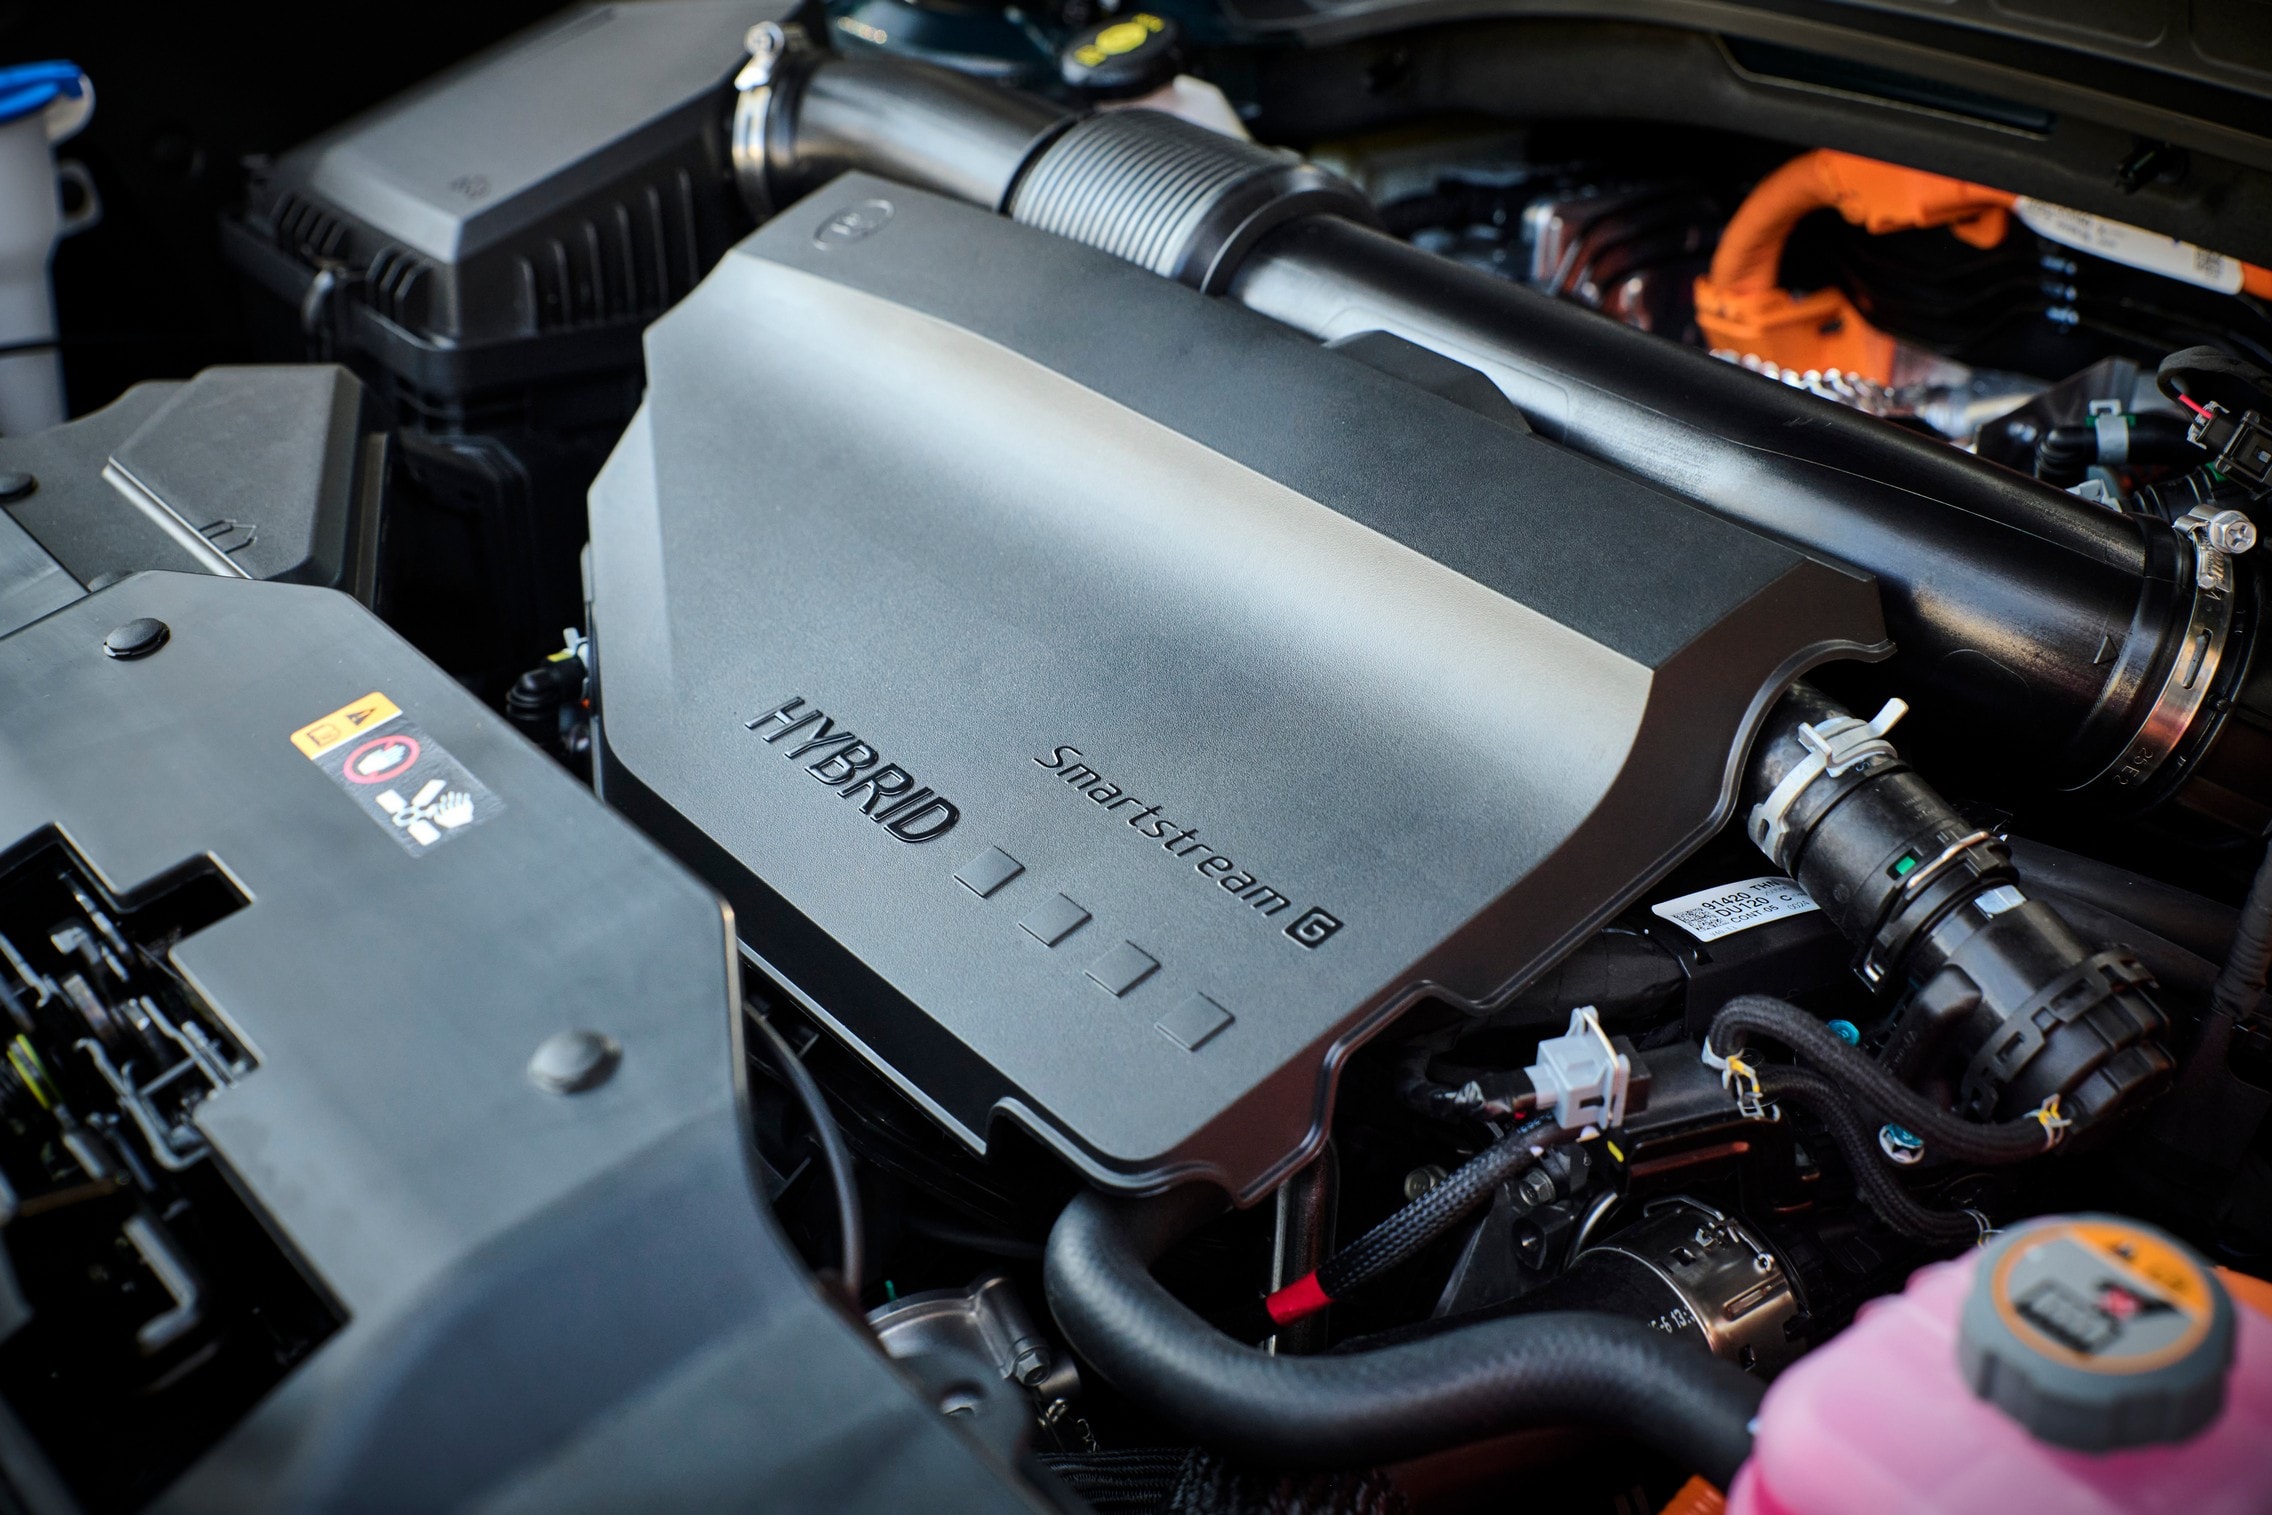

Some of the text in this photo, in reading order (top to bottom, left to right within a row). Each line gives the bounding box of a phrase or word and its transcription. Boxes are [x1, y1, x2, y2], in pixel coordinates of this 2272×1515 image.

[744, 696, 960, 844] HYBRID
[1032, 745, 1292, 918] Smartstream
[1701, 891, 1751, 910] 91420
[1715, 896, 1770, 917] DU120
